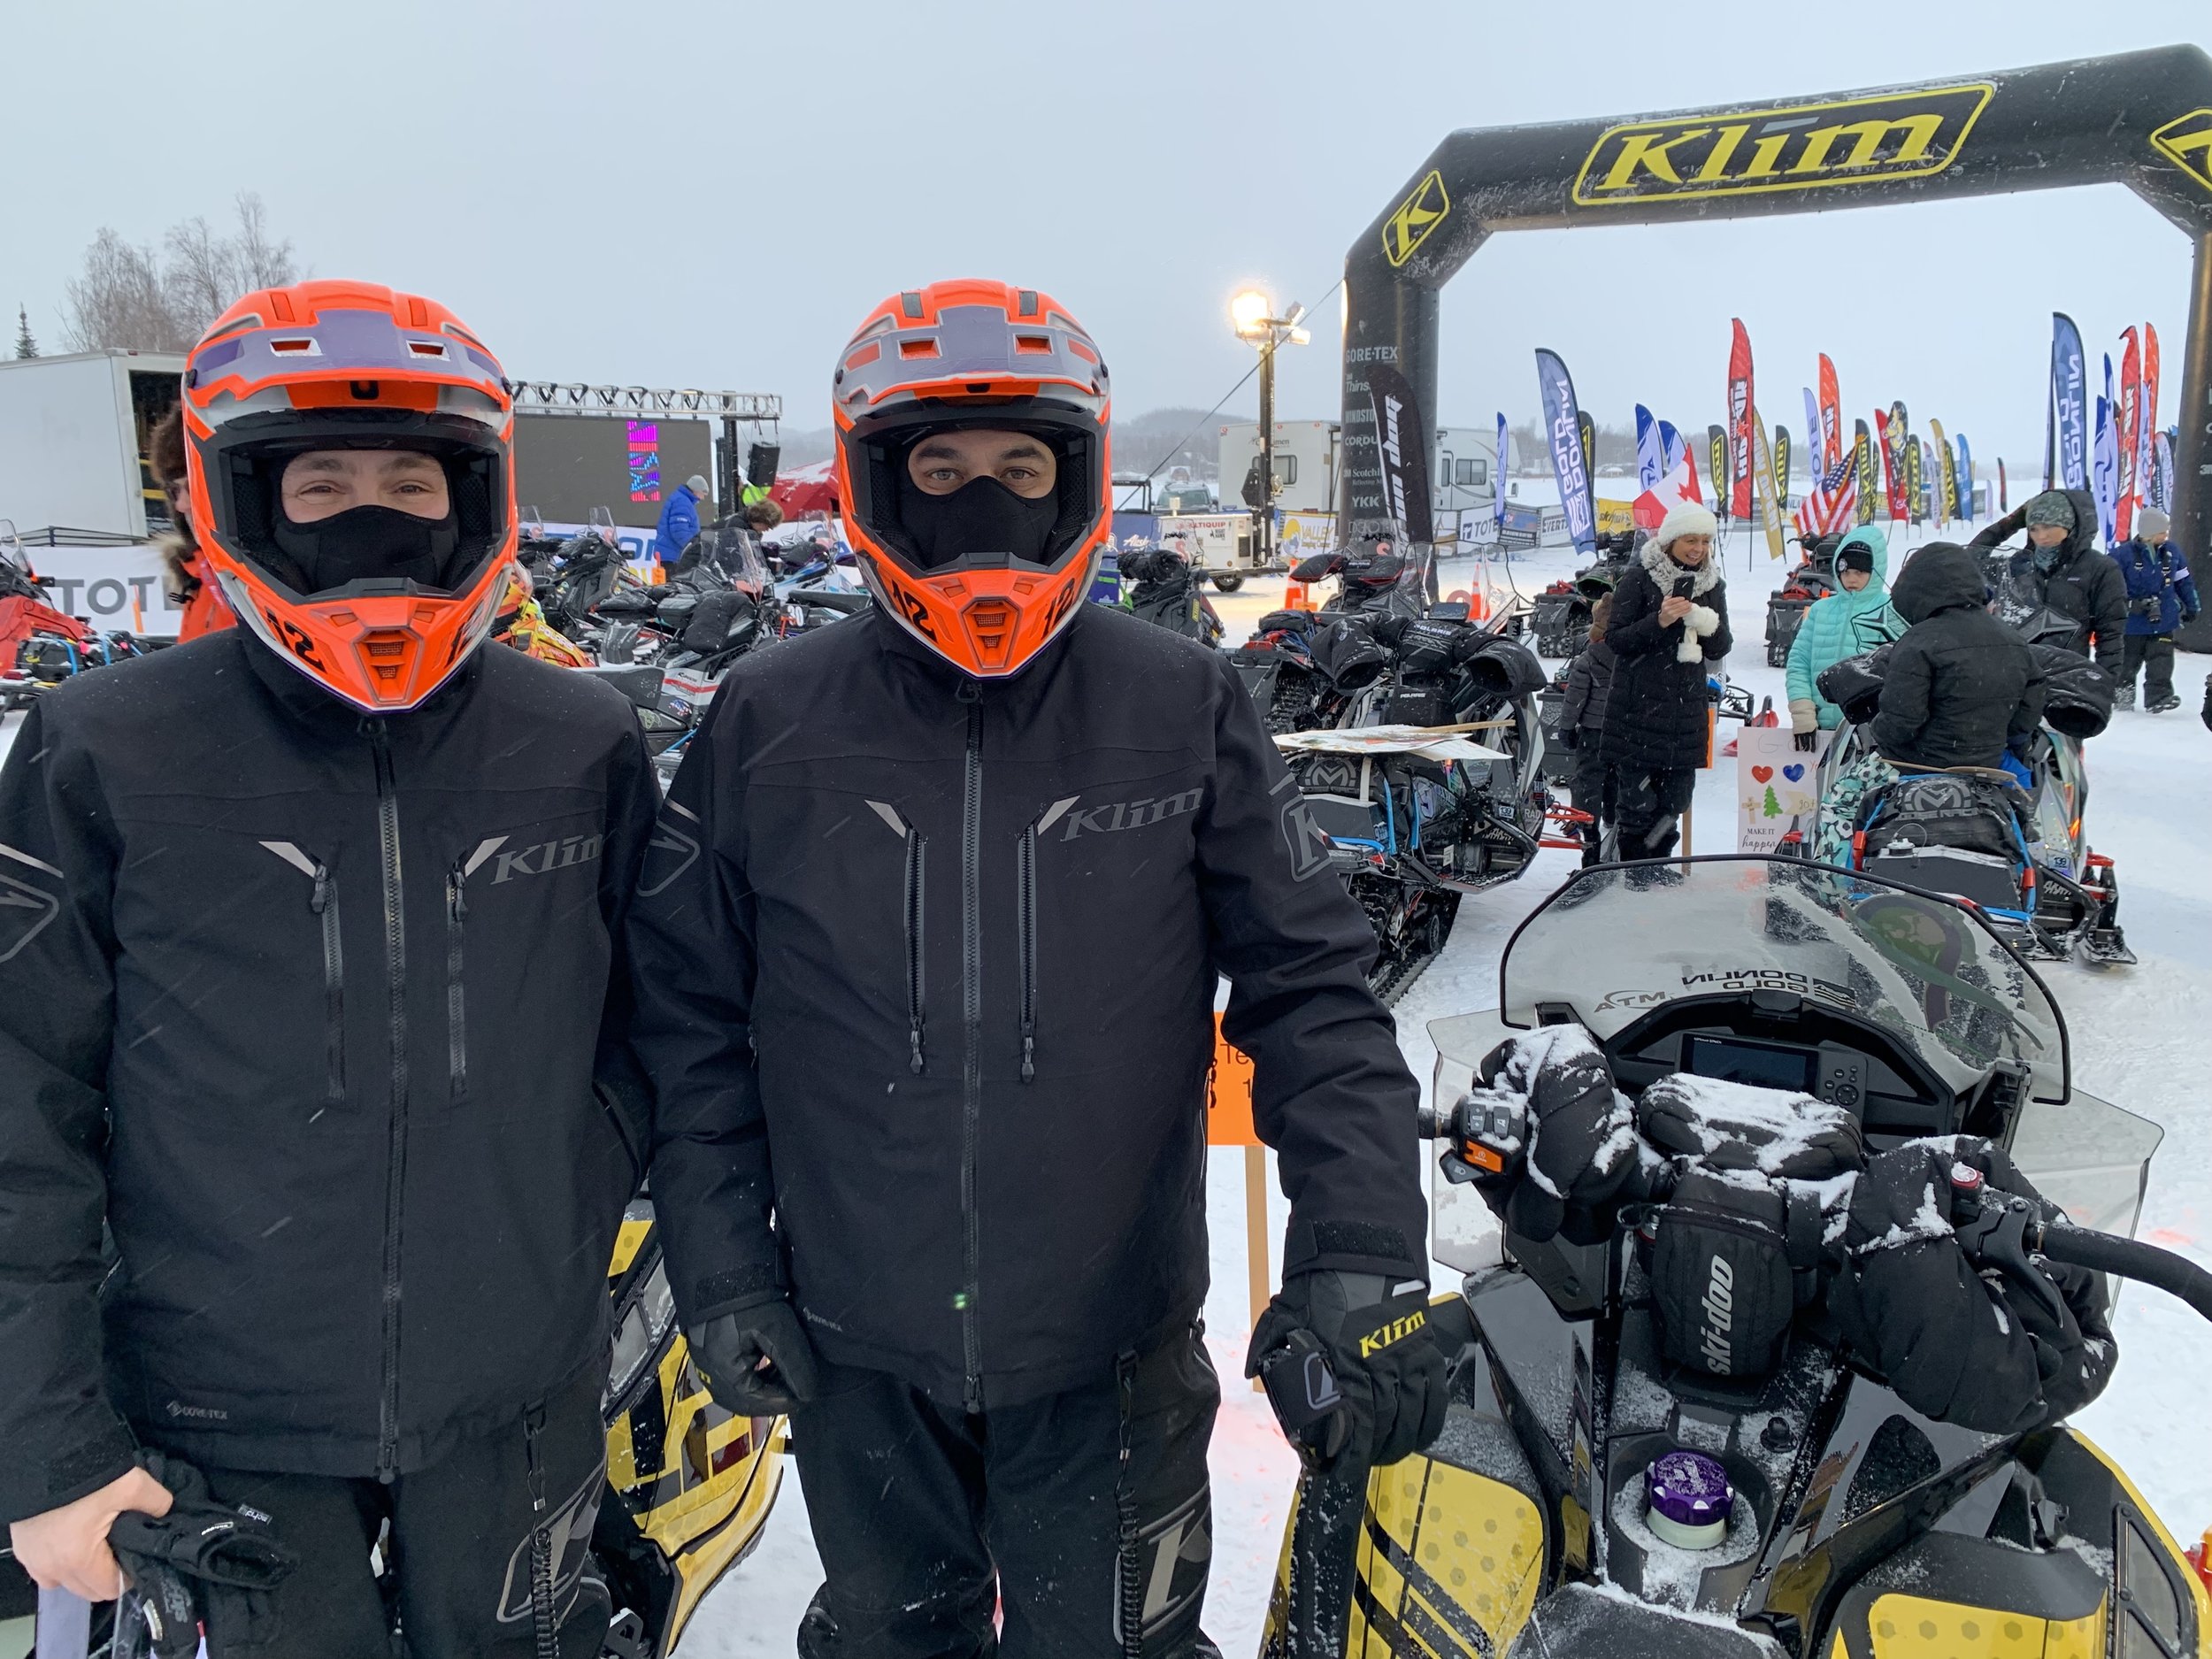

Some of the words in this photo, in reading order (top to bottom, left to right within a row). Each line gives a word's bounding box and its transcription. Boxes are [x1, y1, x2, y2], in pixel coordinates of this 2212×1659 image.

[1596, 111, 1944, 189] Klim
[1352, 496, 1379, 507] YKK
[265, 608, 328, 674] 12
[787, 604, 804, 627] 30
[892, 580, 938, 644] 12
[1060, 787, 1203, 842] Klim
[1358, 1310, 1426, 1359] Klim
[1701, 1254, 1733, 1376] ski-doo
